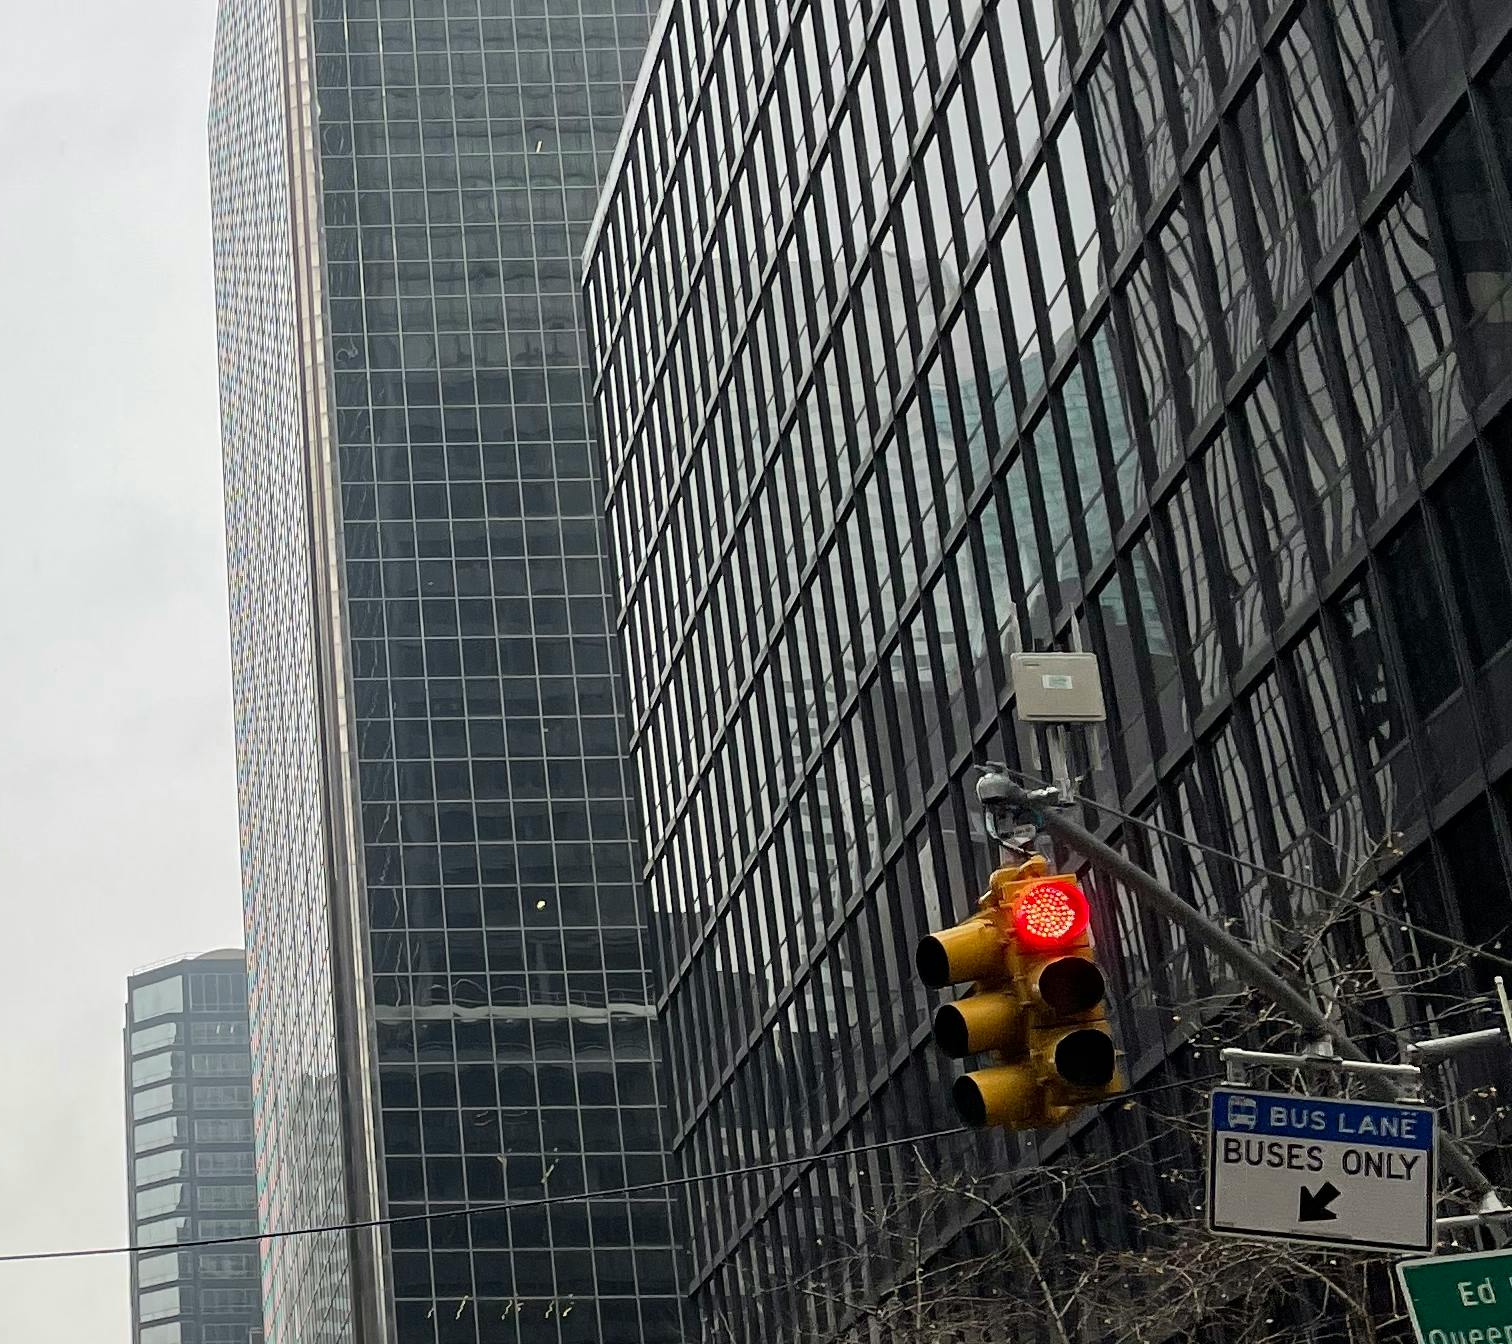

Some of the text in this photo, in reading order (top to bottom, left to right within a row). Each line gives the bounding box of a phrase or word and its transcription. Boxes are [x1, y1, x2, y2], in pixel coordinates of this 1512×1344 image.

[1269, 1106, 1417, 1140] BUS LANE
[1223, 1137, 1420, 1181] BUSES ONLY
[1457, 1277, 1497, 1306] Ed
